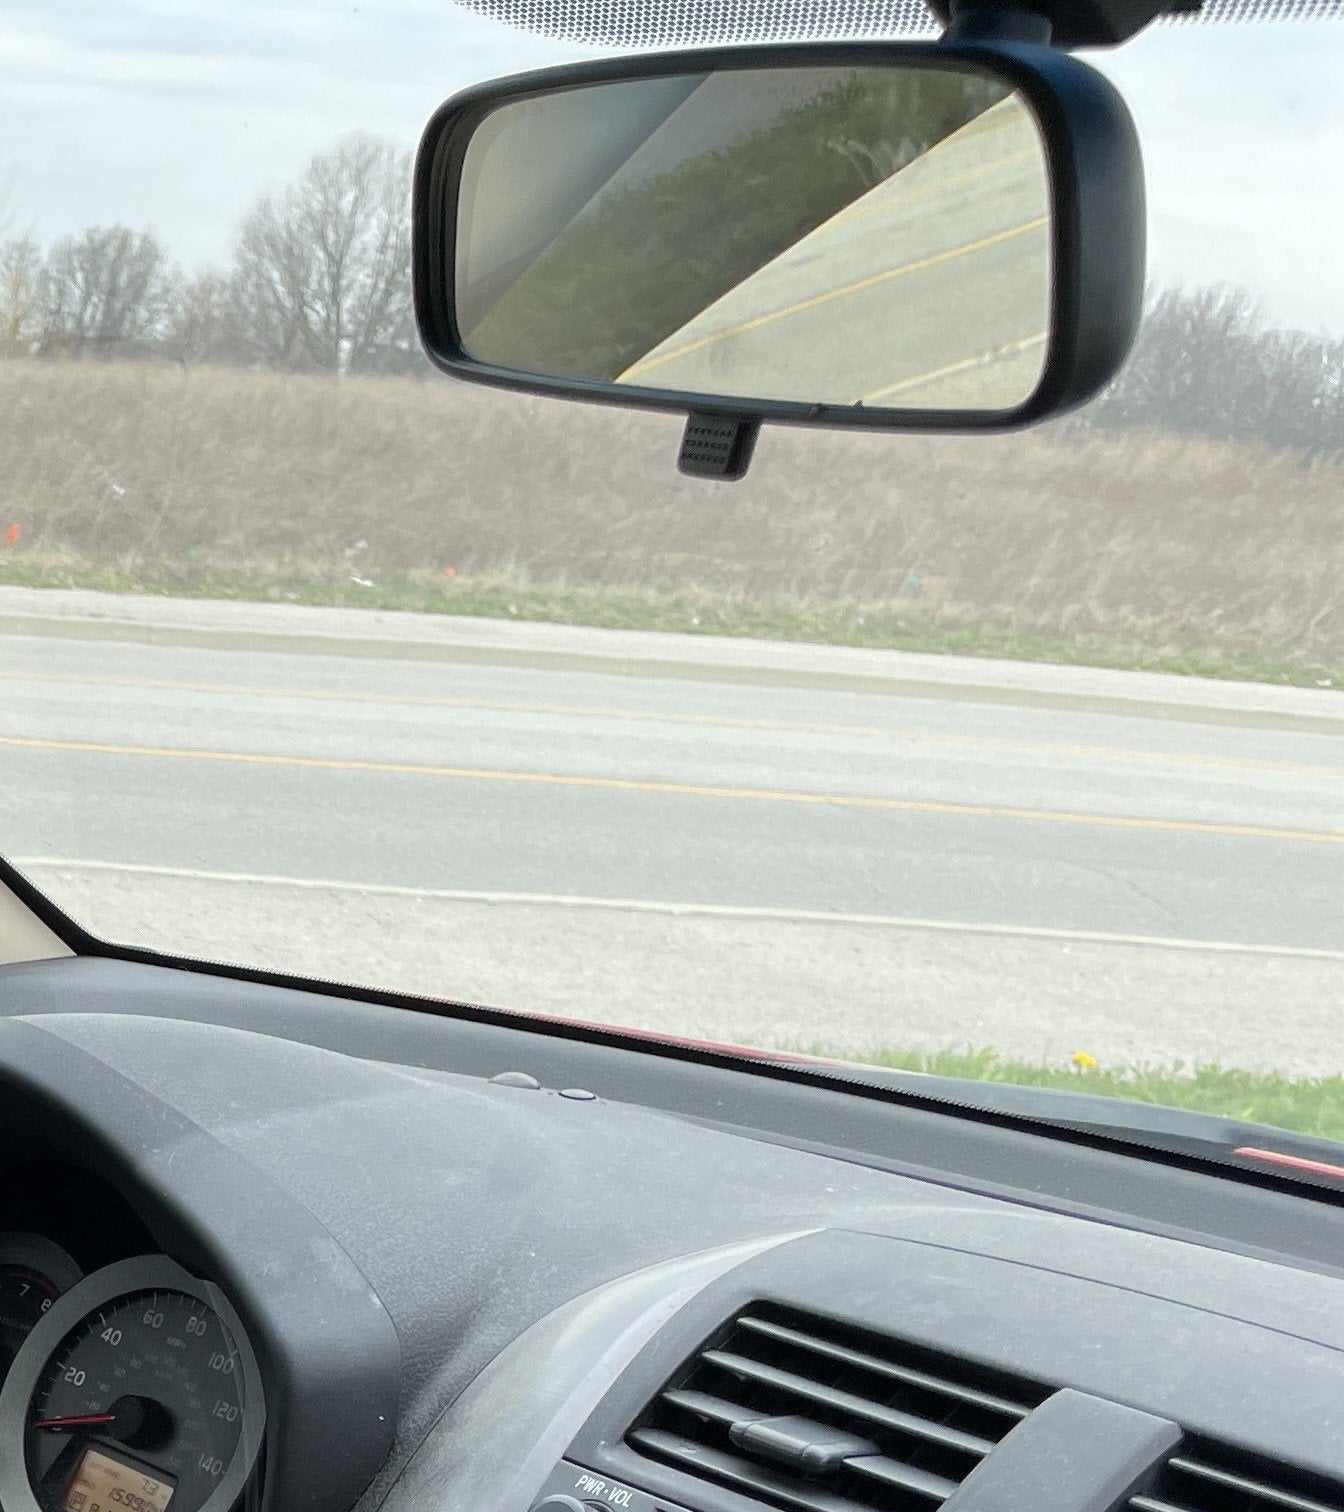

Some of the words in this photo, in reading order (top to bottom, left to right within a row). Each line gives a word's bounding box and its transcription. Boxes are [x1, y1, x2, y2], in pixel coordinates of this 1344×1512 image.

[19, 1283, 31, 1296] 7
[142, 1309, 164, 1329] 60
[185, 1316, 207, 1337] 80
[100, 1327, 123, 1346] 40
[208, 1353, 235, 1375] 100
[64, 1366, 87, 1386] 20
[213, 1400, 238, 1422] 120
[197, 1452, 223, 1476] 140
